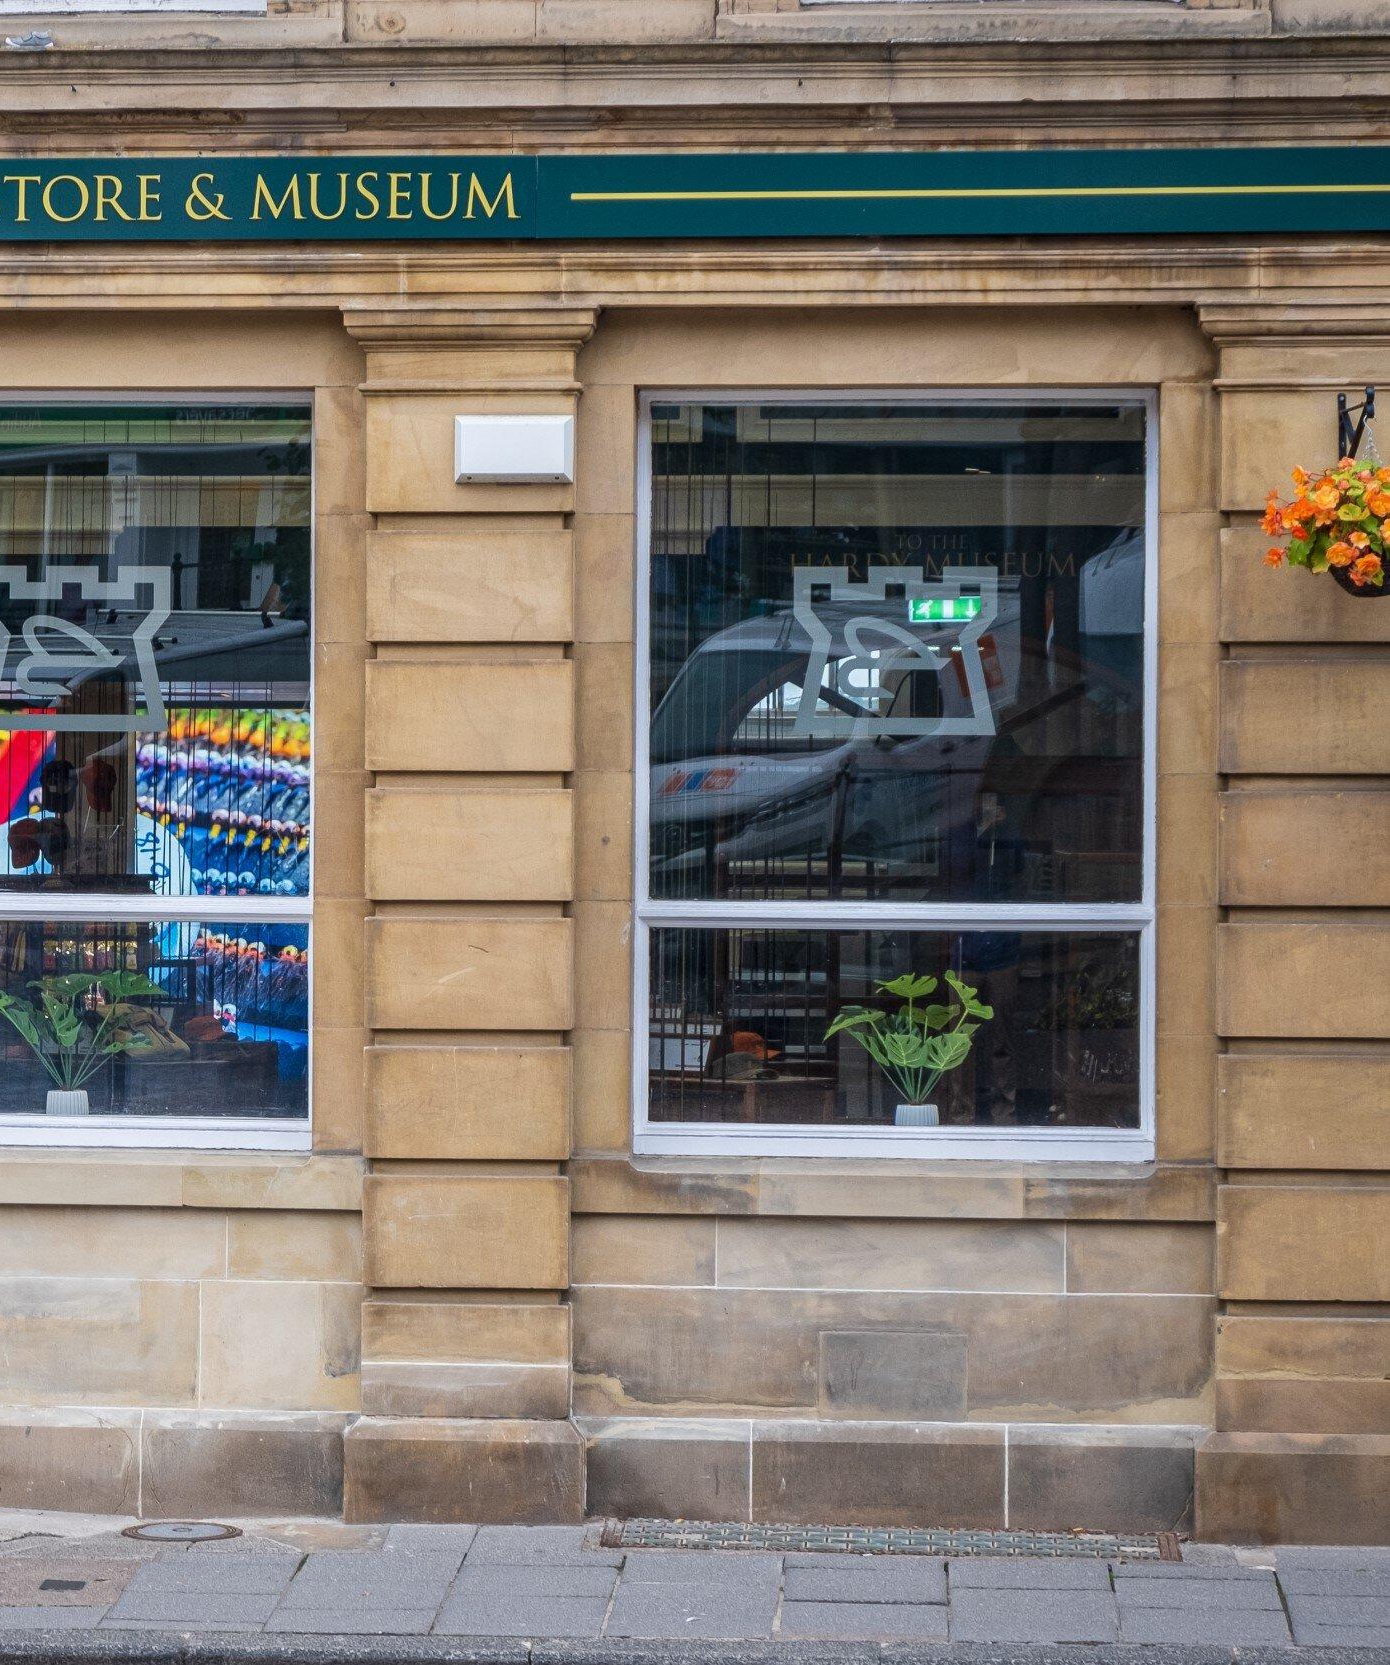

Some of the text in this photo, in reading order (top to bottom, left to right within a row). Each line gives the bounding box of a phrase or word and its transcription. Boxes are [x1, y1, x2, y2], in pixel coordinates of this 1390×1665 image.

[185, 173, 232, 221] &
[249, 171, 521, 221] MUSEUM
[895, 534, 967, 550] TO THE
[925, 552, 1076, 577] MUSEUM
